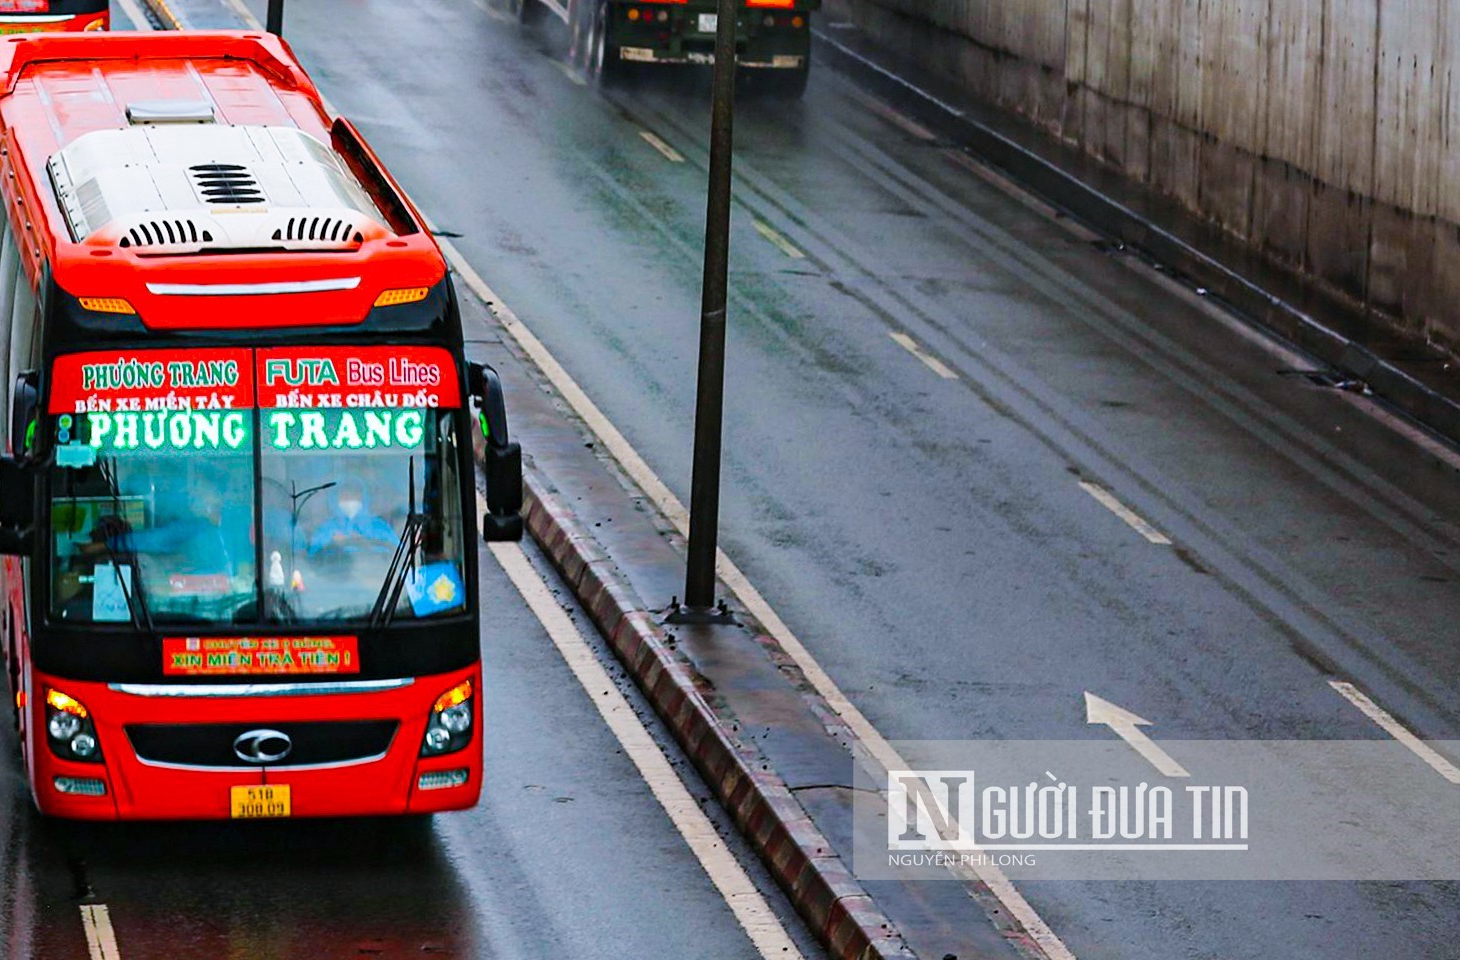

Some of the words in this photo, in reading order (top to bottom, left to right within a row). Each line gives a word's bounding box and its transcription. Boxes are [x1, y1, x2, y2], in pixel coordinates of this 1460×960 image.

[82, 357, 164, 389] PHƯƠNG
[168, 360, 239, 387] TRANG
[266, 358, 340, 386] FUTA
[346, 358, 384, 386] Bus
[389, 358, 440, 386] Lines
[75, 393, 111, 413] BẾN
[116, 397, 141, 412] XE
[196, 392, 235, 409] TÂY
[276, 389, 313, 408] BẾN
[317, 394, 342, 408] XE
[346, 390, 398, 408] CHÂU
[88, 407, 246, 450] PHƯƠNG
[269, 409, 424, 450] TRANG
[172, 653, 202, 667] XIN
